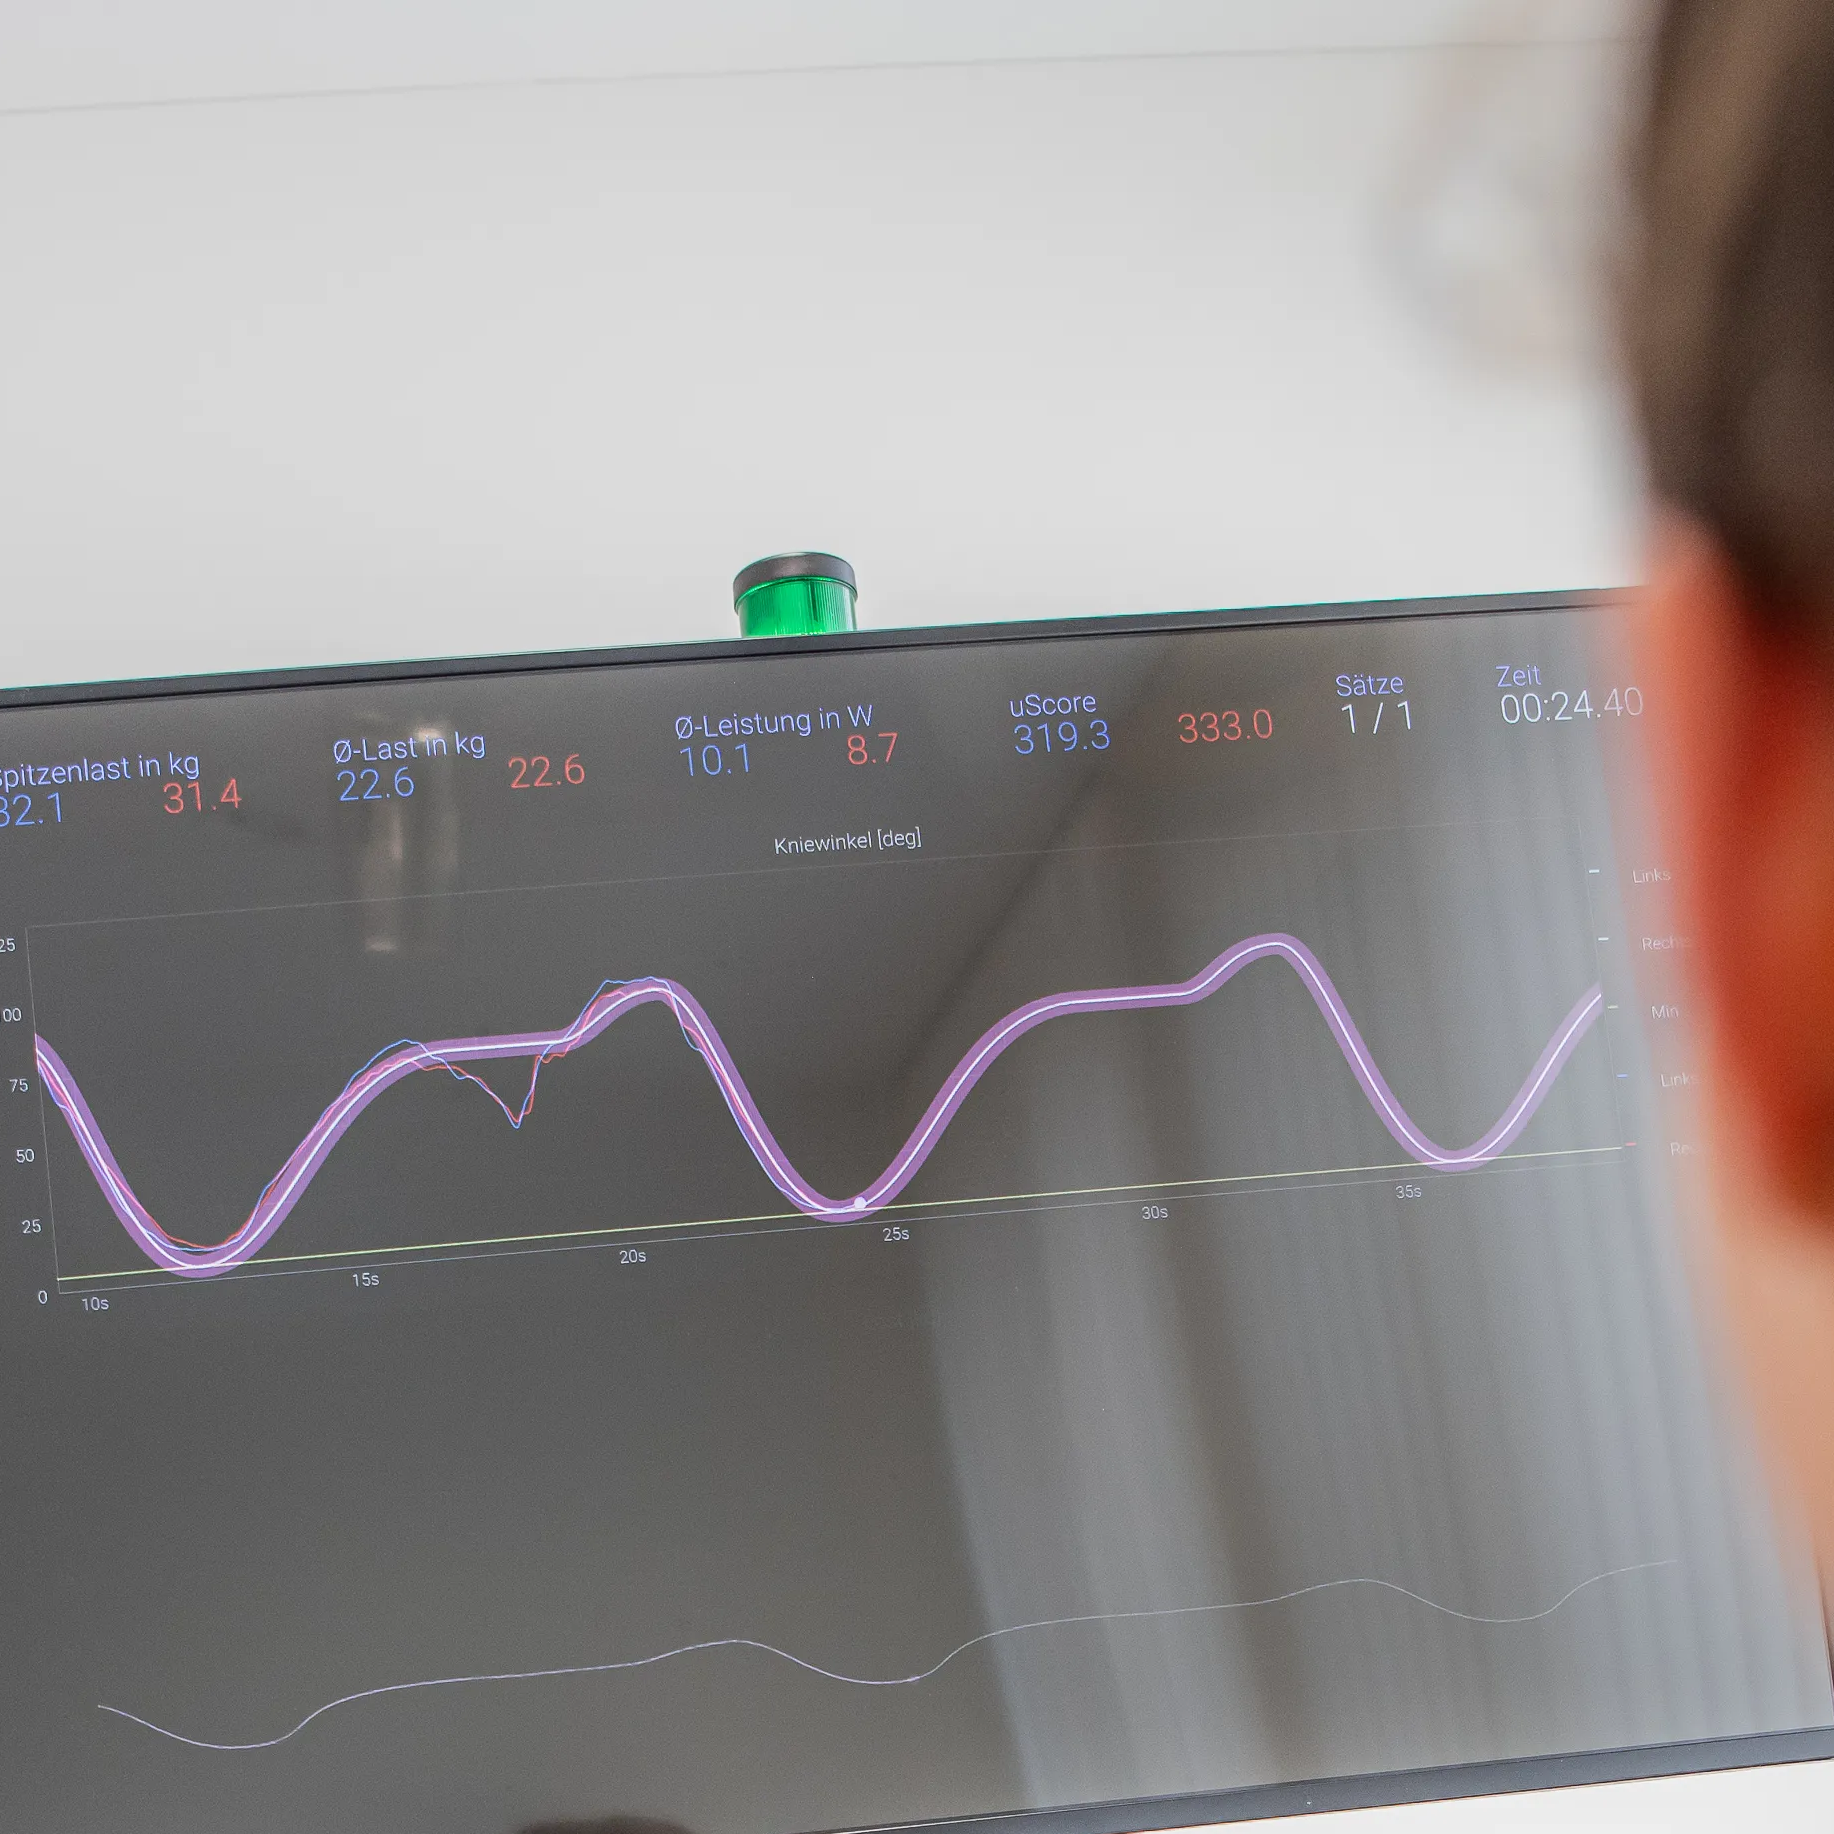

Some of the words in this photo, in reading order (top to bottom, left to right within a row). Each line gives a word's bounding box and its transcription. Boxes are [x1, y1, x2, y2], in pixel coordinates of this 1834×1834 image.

[1335, 672, 1404, 697] Sätze
[1496, 664, 1542, 688] Zeit
[819, 708, 840, 729] in
[847, 704, 873, 727] W
[1010, 692, 1097, 717] uScore
[1341, 704, 1355, 733] 1
[1398, 701, 1412, 730] 1
[1500, 686, 1644, 724] 00:24.40
[1014, 720, 1111, 755] 319.3
[1178, 708, 1274, 744] 333.0
[424, 735, 447, 757] in
[454, 731, 486, 760] kg
[680, 743, 751, 777] 10.1
[847, 732, 898, 766] 8.7
[138, 756, 161, 777] in
[167, 752, 200, 780] kg
[338, 766, 416, 801] 22.6
[509, 754, 586, 789] 22.6
[164, 778, 242, 814] 31.4
[775, 832, 872, 855] Kniewinkel
[878, 826, 922, 852] [deg]
[9, 1078, 29, 1093] 75
[15, 1148, 35, 1164] 50
[1395, 1183, 1422, 1200] 35s
[1141, 1204, 1169, 1221] 30s
[21, 1219, 42, 1235] 25
[882, 1225, 910, 1243] 25s
[619, 1248, 647, 1265] 20s
[352, 1271, 380, 1288] 15s
[38, 1289, 48, 1305] 0
[81, 1296, 110, 1312] 10s
